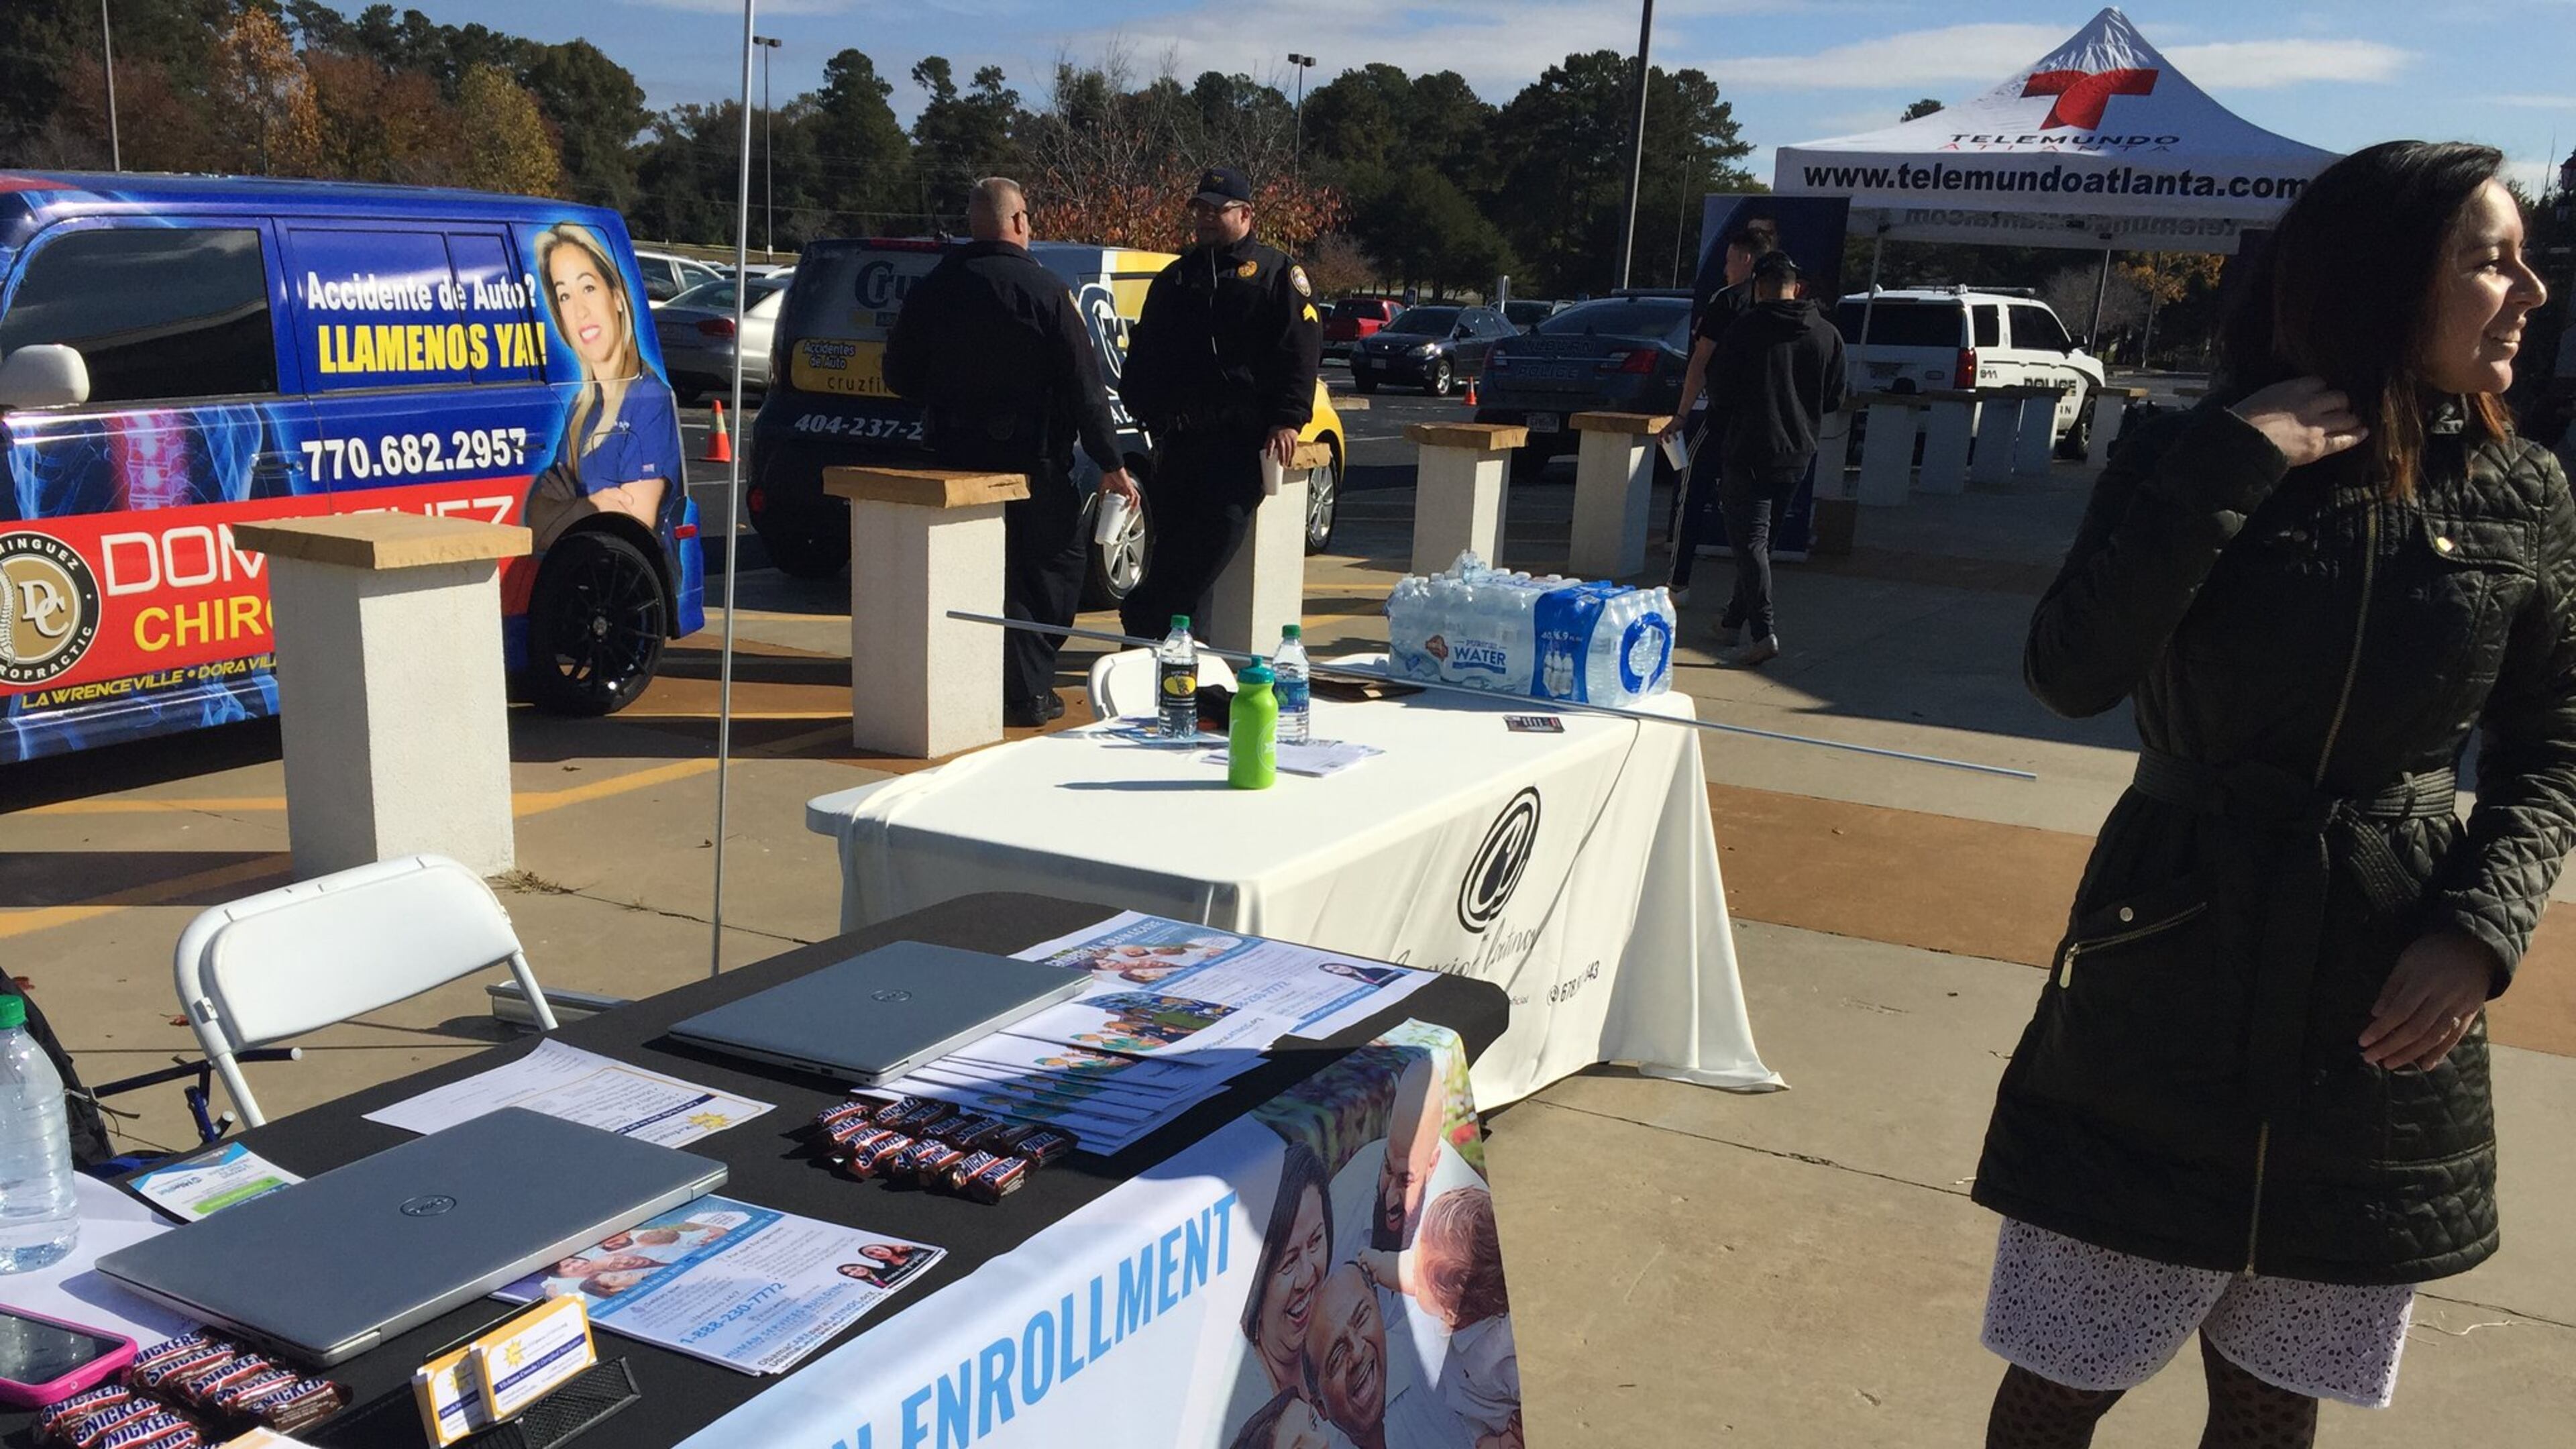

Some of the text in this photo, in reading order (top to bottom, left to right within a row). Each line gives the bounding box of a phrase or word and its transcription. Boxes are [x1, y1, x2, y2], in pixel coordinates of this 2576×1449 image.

[1950, 134, 2181, 145] TELEMUNDO
[307, 271, 537, 311] Accidente de Auto?
[318, 321, 547, 373] LLAMENOS YA!
[804, 341, 856, 358] Accidentes
[809, 356, 847, 370] de Auto
[1517, 365, 1580, 380] POLICE
[1980, 370, 1998, 379] 911
[301, 427, 527, 482] 770.682.2957
[1454, 646, 1507, 666] WATER
[680, 1282, 788, 1345] 1-888-230-7772
[901, 1189, 1237, 1449] ENROLLMENT
[722, 1335, 763, 1359] HUMAN
